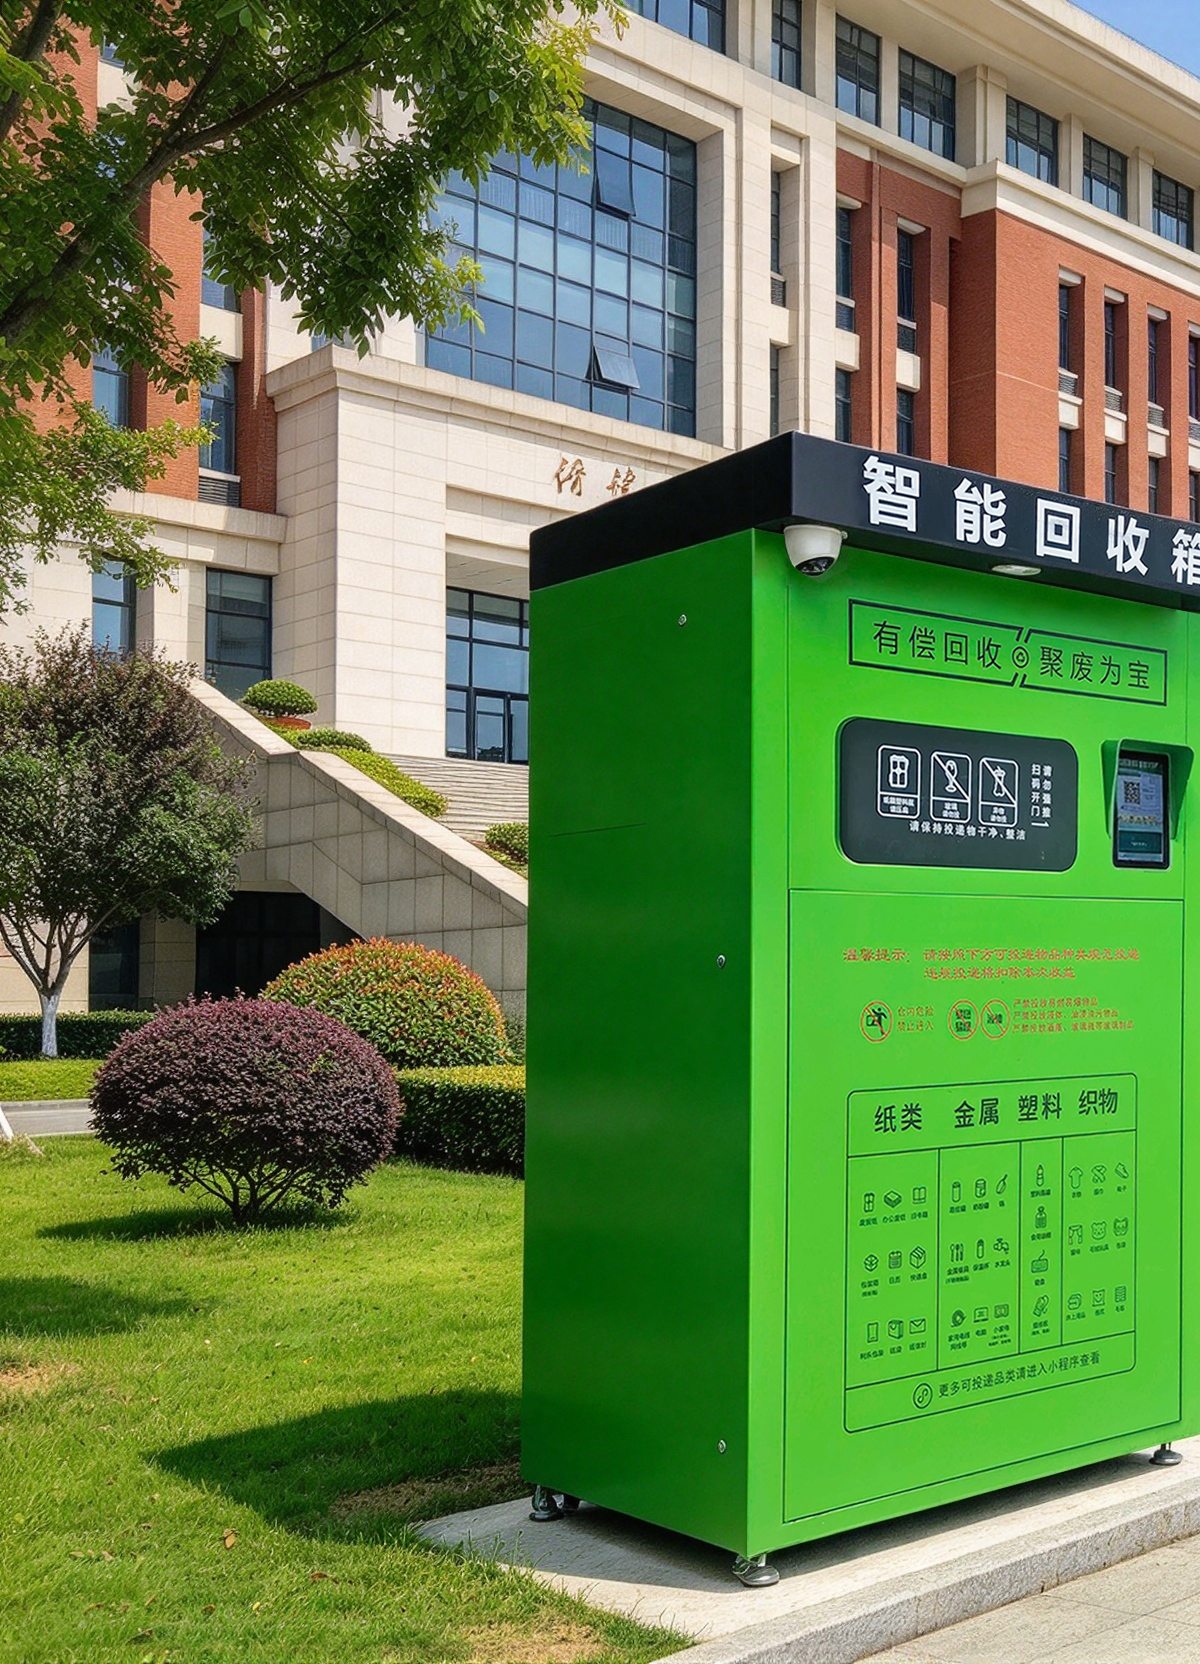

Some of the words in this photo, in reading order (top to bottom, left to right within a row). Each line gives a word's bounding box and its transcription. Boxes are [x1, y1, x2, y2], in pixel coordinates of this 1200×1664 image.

[873, 620, 1002, 671] 有偿回收
[1040, 646, 1150, 690] 聚废为宝
[1031, 763, 1041, 817] 扫码开门
[909, 820, 1026, 841] 请保持投递物干净、整洁
[874, 1102, 922, 1133] 纸类
[954, 1098, 1000, 1129] 金属
[1018, 1092, 1062, 1122] 塑料
[1078, 1087, 1119, 1116] 织物
[938, 1350, 1100, 1398] 更多可投递品类请进入小程序查看
